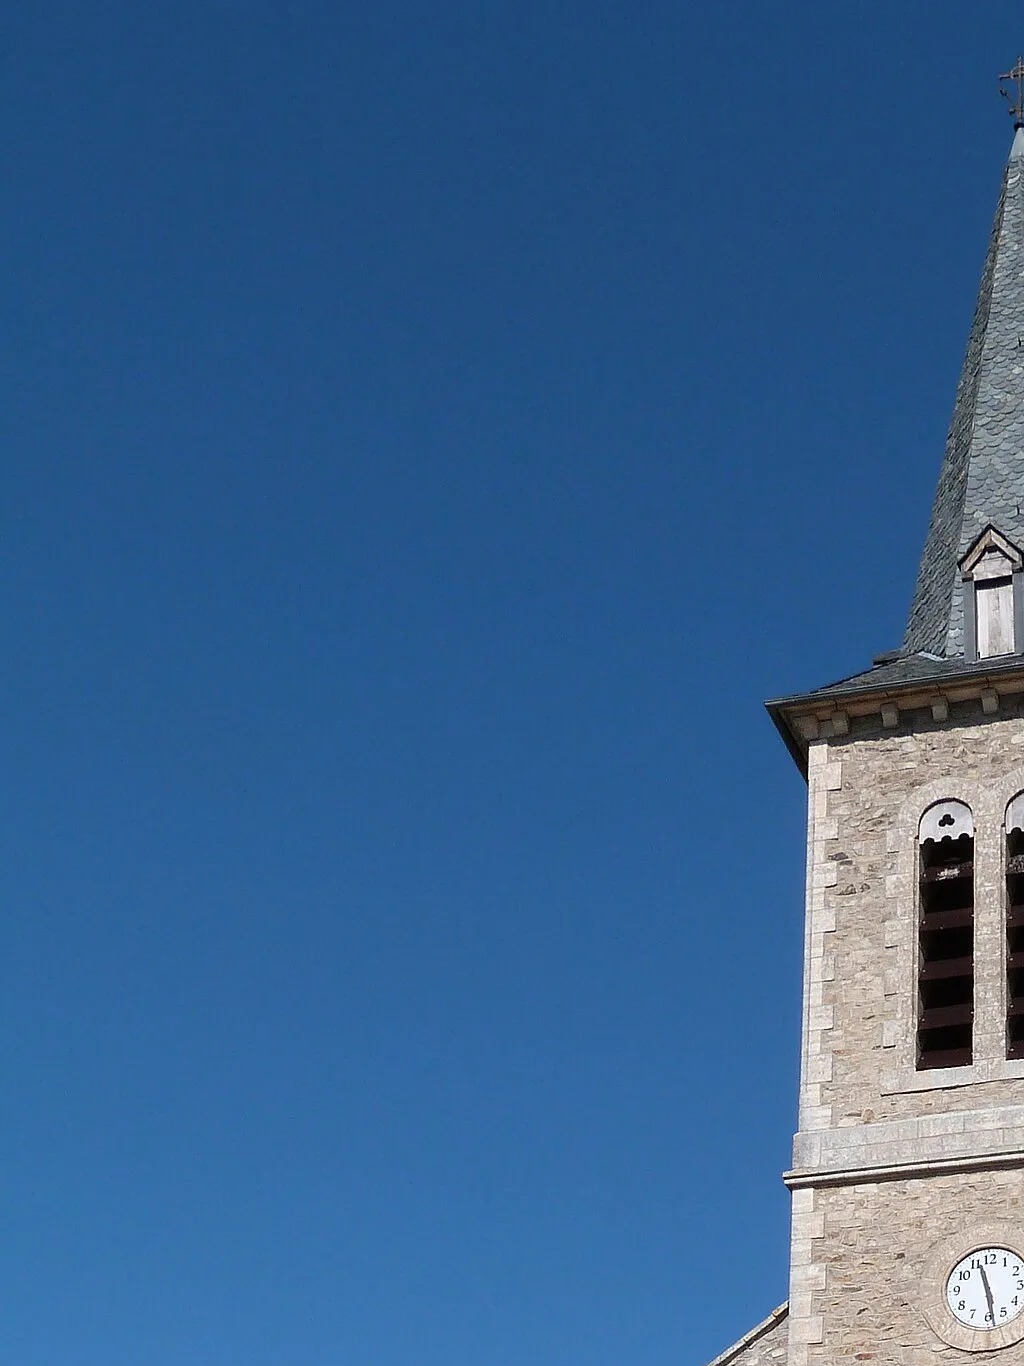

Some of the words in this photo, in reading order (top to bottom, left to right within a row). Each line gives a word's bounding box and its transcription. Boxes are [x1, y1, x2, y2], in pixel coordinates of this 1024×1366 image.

[984, 1254, 997, 1264] 12
[1002, 1257, 1007, 1267] 1
[971, 1259, 980, 1269] 11
[959, 1271, 970, 1280] 10
[1012, 1266, 1019, 1276] 2
[1017, 1280, 1024, 1290] 3
[953, 1286, 960, 1295] 9
[1011, 1296, 1018, 1305] 4
[958, 1301, 965, 1310] 8
[969, 1309, 976, 1319] 7
[985, 1312, 992, 1321] 6
[1000, 1308, 1007, 1317] 5
